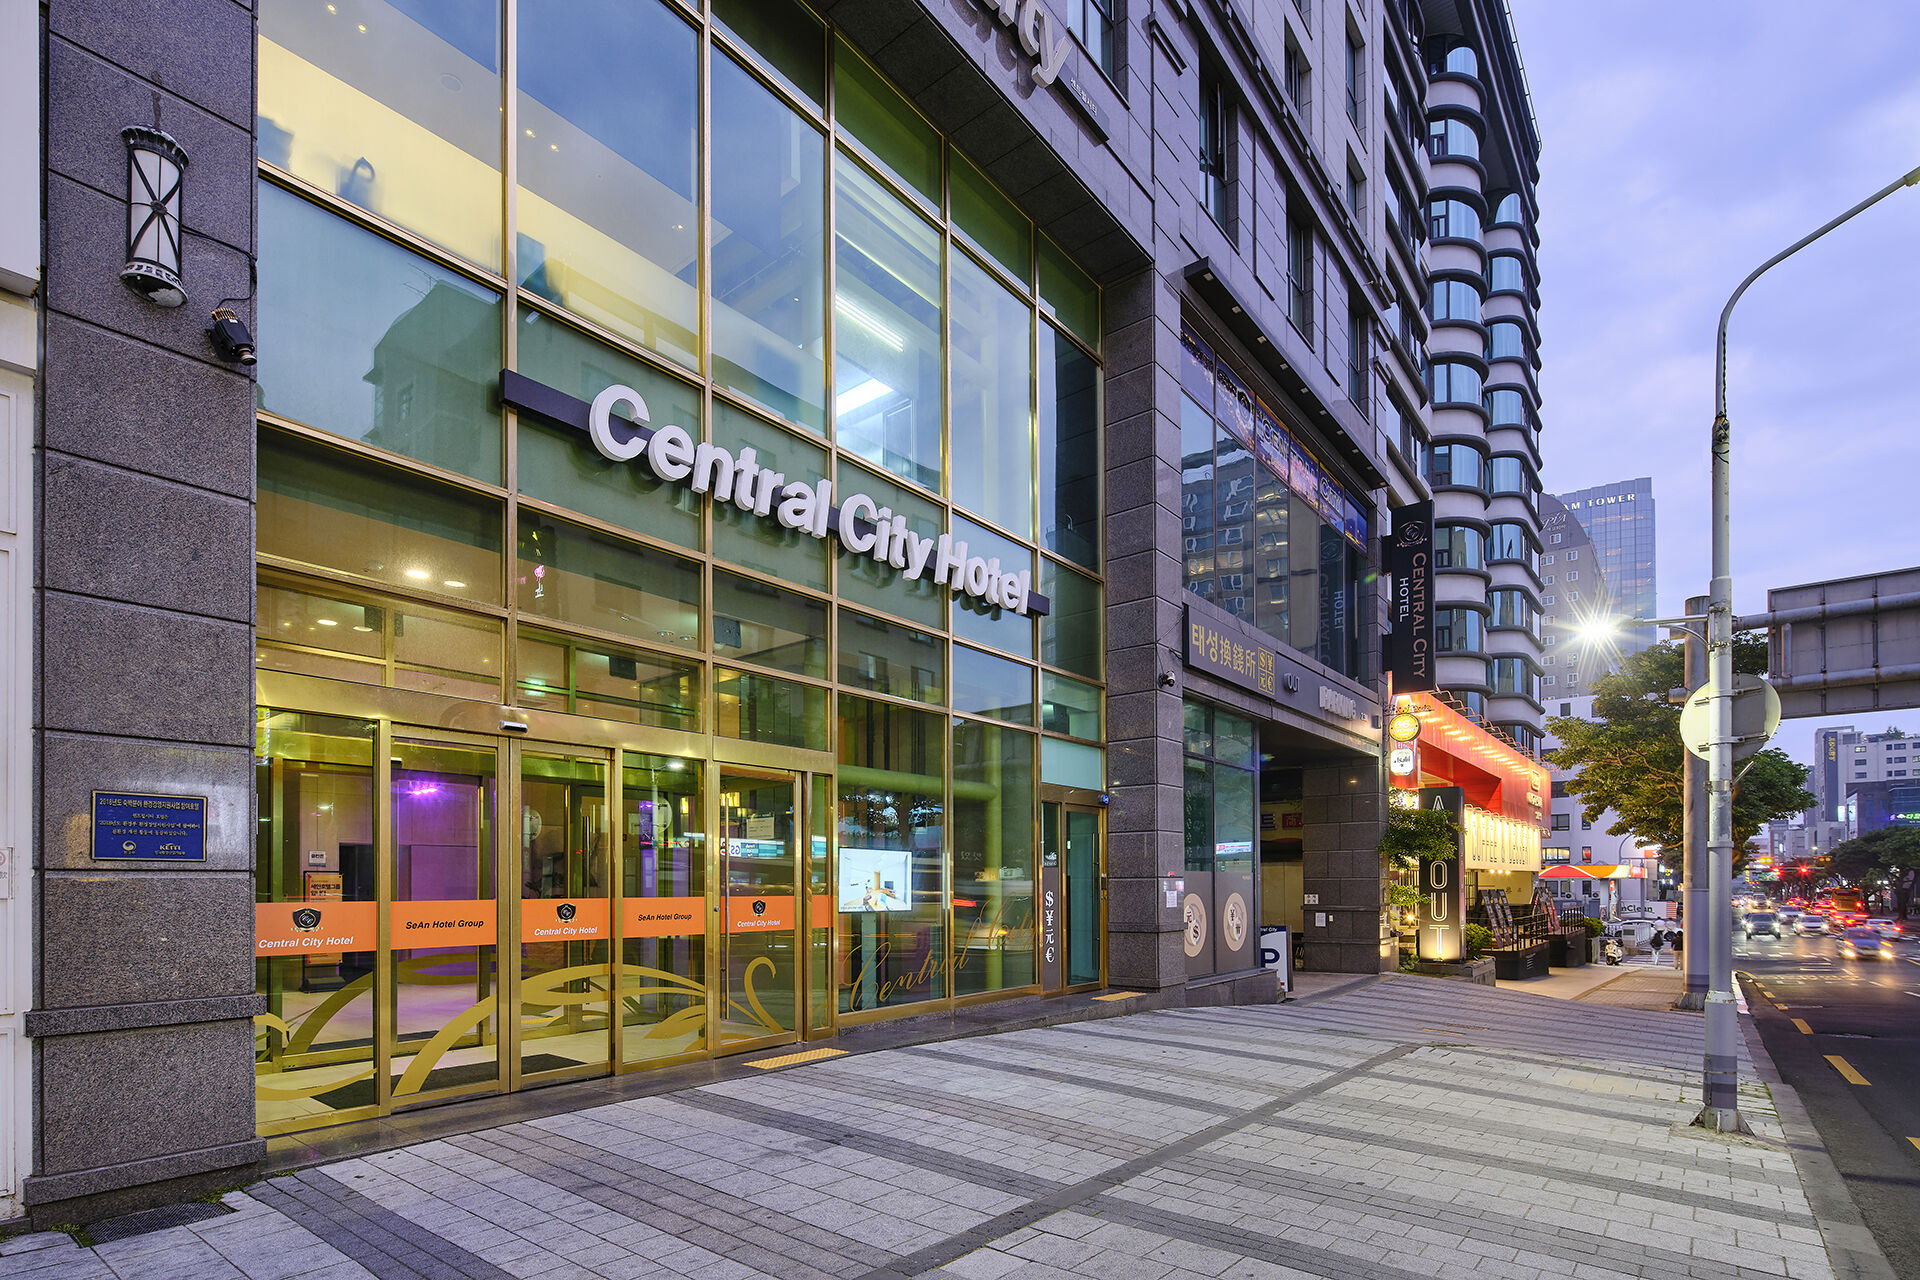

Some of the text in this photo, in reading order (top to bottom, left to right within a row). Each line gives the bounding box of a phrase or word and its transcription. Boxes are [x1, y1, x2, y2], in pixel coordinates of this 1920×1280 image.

[588, 384, 1031, 615] Central City Hotel
[1587, 493, 1636, 507] TOWER
[1399, 577, 1409, 623] HOTEL
[1412, 552, 1427, 679] CENTRAL CITY
[1191, 623, 1256, 680] 태성換錢所
[1259, 651, 1266, 668] $
[1319, 685, 1357, 720] PARKING
[1428, 795, 1450, 954] AOUT
[405, 919, 484, 930] SeAn Hotel Group
[637, 912, 693, 923] SeAn Hotel Group
[737, 918, 781, 929] Central City Hotel
[534, 925, 598, 937] Central City Hotel
[258, 935, 354, 949] Central City Hotel
[841, 915, 983, 1012] Central
[1260, 948, 1280, 968] P
